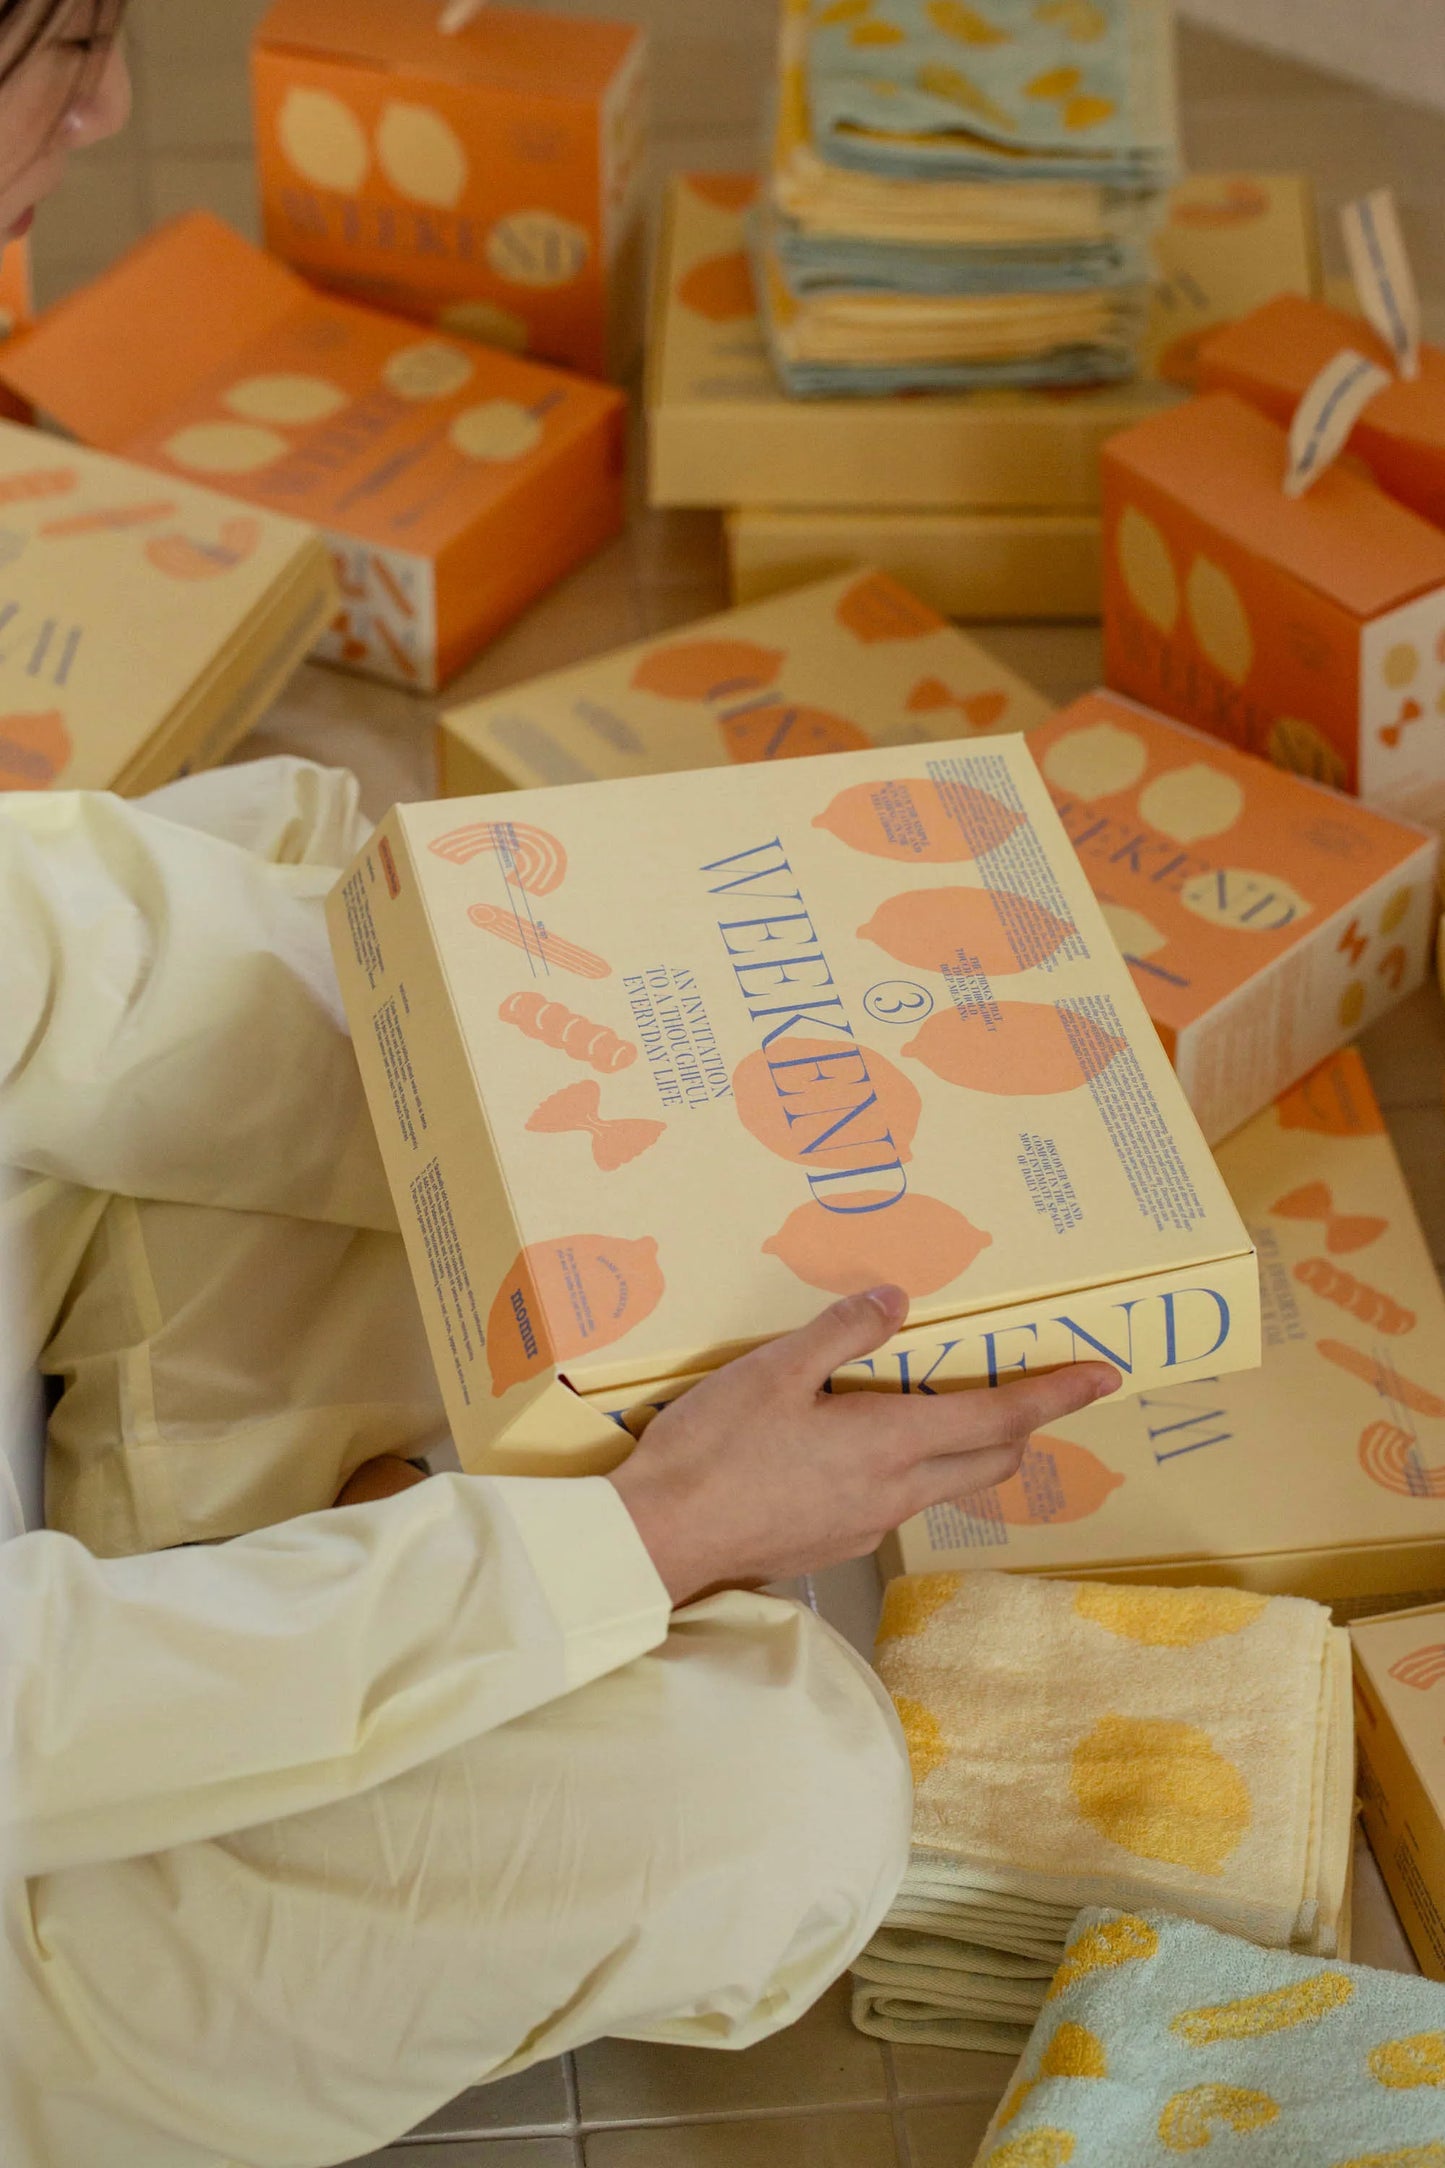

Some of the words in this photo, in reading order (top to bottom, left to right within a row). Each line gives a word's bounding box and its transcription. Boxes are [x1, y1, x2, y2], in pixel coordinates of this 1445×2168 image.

[644, 964, 671, 989] TO
[670, 965, 697, 990] AN
[653, 991, 676, 1004] A
[700, 836, 907, 1215] WEEKEND
[622, 975, 670, 1064] EVERYDAY
[651, 1068, 683, 1107] LIFE
[680, 995, 733, 1098] INVITATION
[657, 1005, 710, 1109] THOUGHFUL
[1015, 1154, 1028, 1166] OF
[1030, 1134, 1054, 1175] COMFORT
[1018, 1132, 1036, 1157] MOST
[1028, 1158, 1053, 1201] INTIMATE
[1046, 1202, 1067, 1234] SPACES
[1021, 1167, 1039, 1192] DAILY
[1043, 1138, 1068, 1180] DISCOVER
[1061, 1182, 1075, 1199] WIT
[1068, 1201, 1084, 1220] AND
[1047, 1177, 1059, 1187] IN
[1031, 1194, 1047, 1214] LIFE
[1052, 1188, 1066, 1205] THE
[1059, 1206, 1076, 1228] TWO
[510, 1288, 538, 1360] momur
